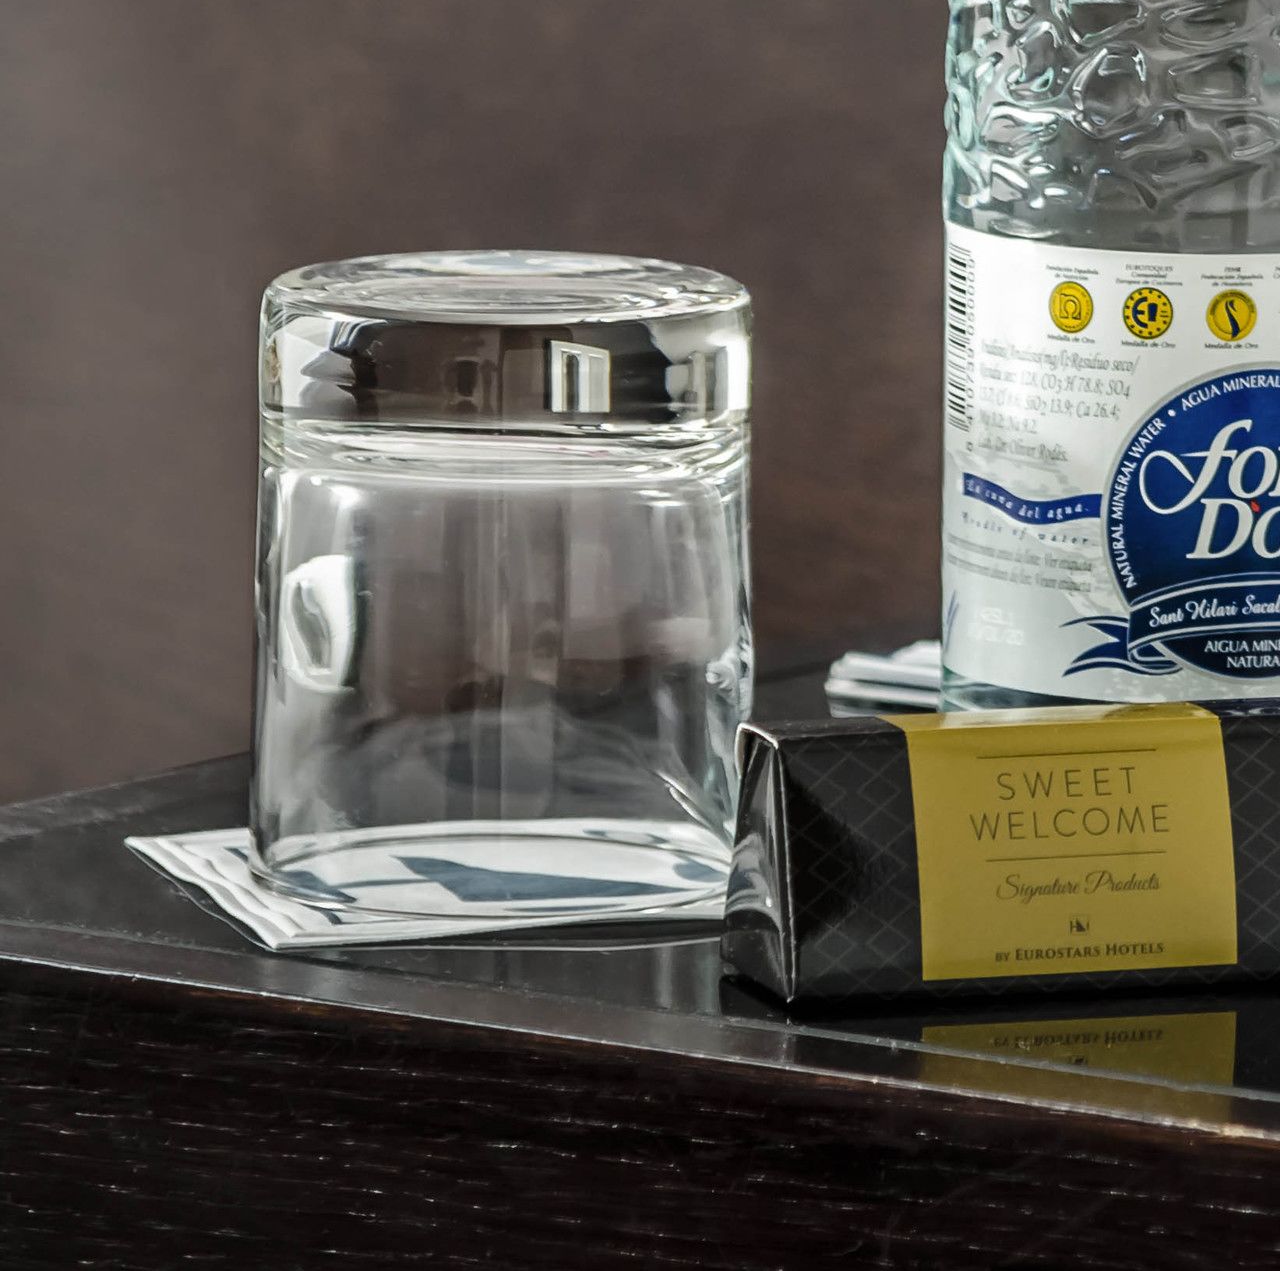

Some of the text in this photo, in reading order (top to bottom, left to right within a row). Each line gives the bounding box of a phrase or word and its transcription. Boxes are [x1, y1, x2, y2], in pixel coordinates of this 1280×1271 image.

[1181, 386, 1221, 412] AGUA
[1018, 504, 1040, 519] del
[1111, 417, 1167, 589] NATURAL MINERAL WATER
[1149, 606, 1184, 628] Sant
[1185, 598, 1239, 620] Hilari
[1204, 639, 1250, 653] AIGUA
[996, 766, 1135, 801] SWEET
[969, 804, 1170, 841] WELCOME
[996, 870, 1161, 905] Signature Products
[995, 942, 1164, 962] BY EUROSTARS HOTELS
